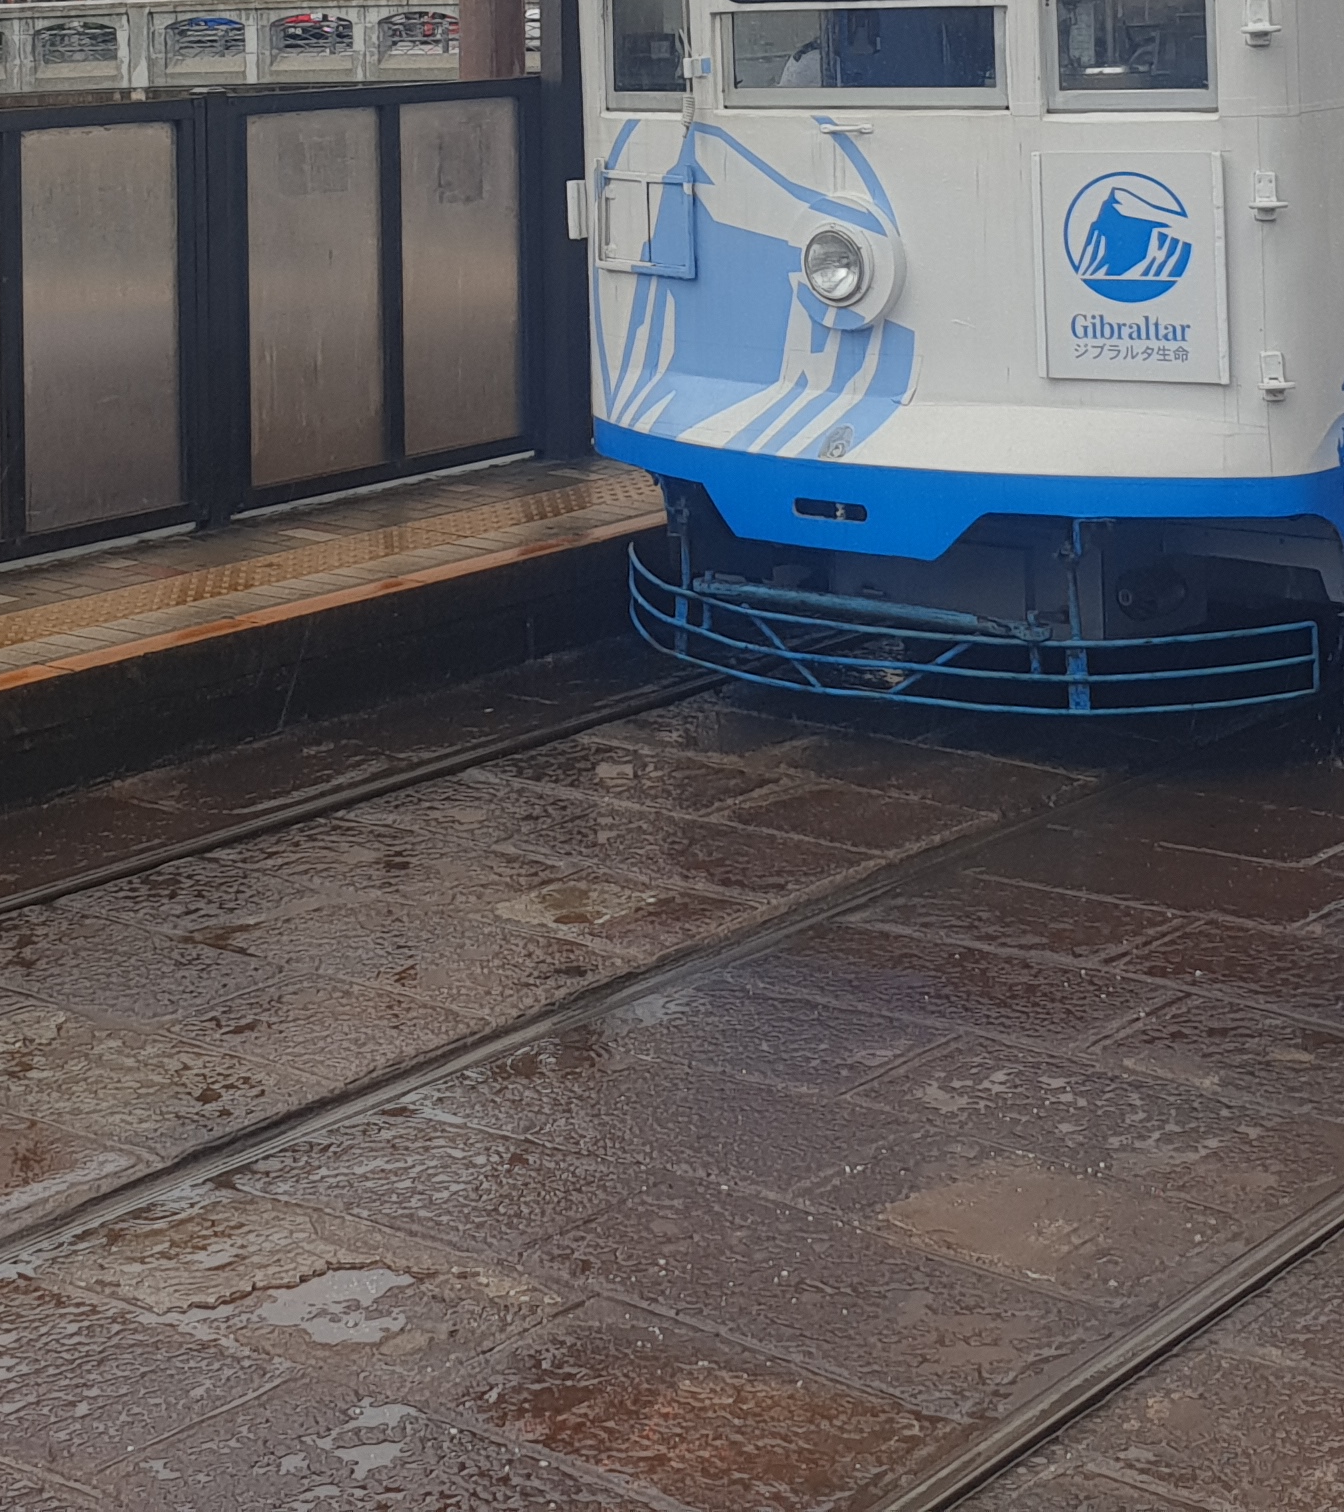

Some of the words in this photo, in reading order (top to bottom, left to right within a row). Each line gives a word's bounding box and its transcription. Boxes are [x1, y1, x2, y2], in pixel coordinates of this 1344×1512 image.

[1071, 313, 1191, 342] Gibraltar
[1074, 343, 1190, 363] ジブラルタ生命
